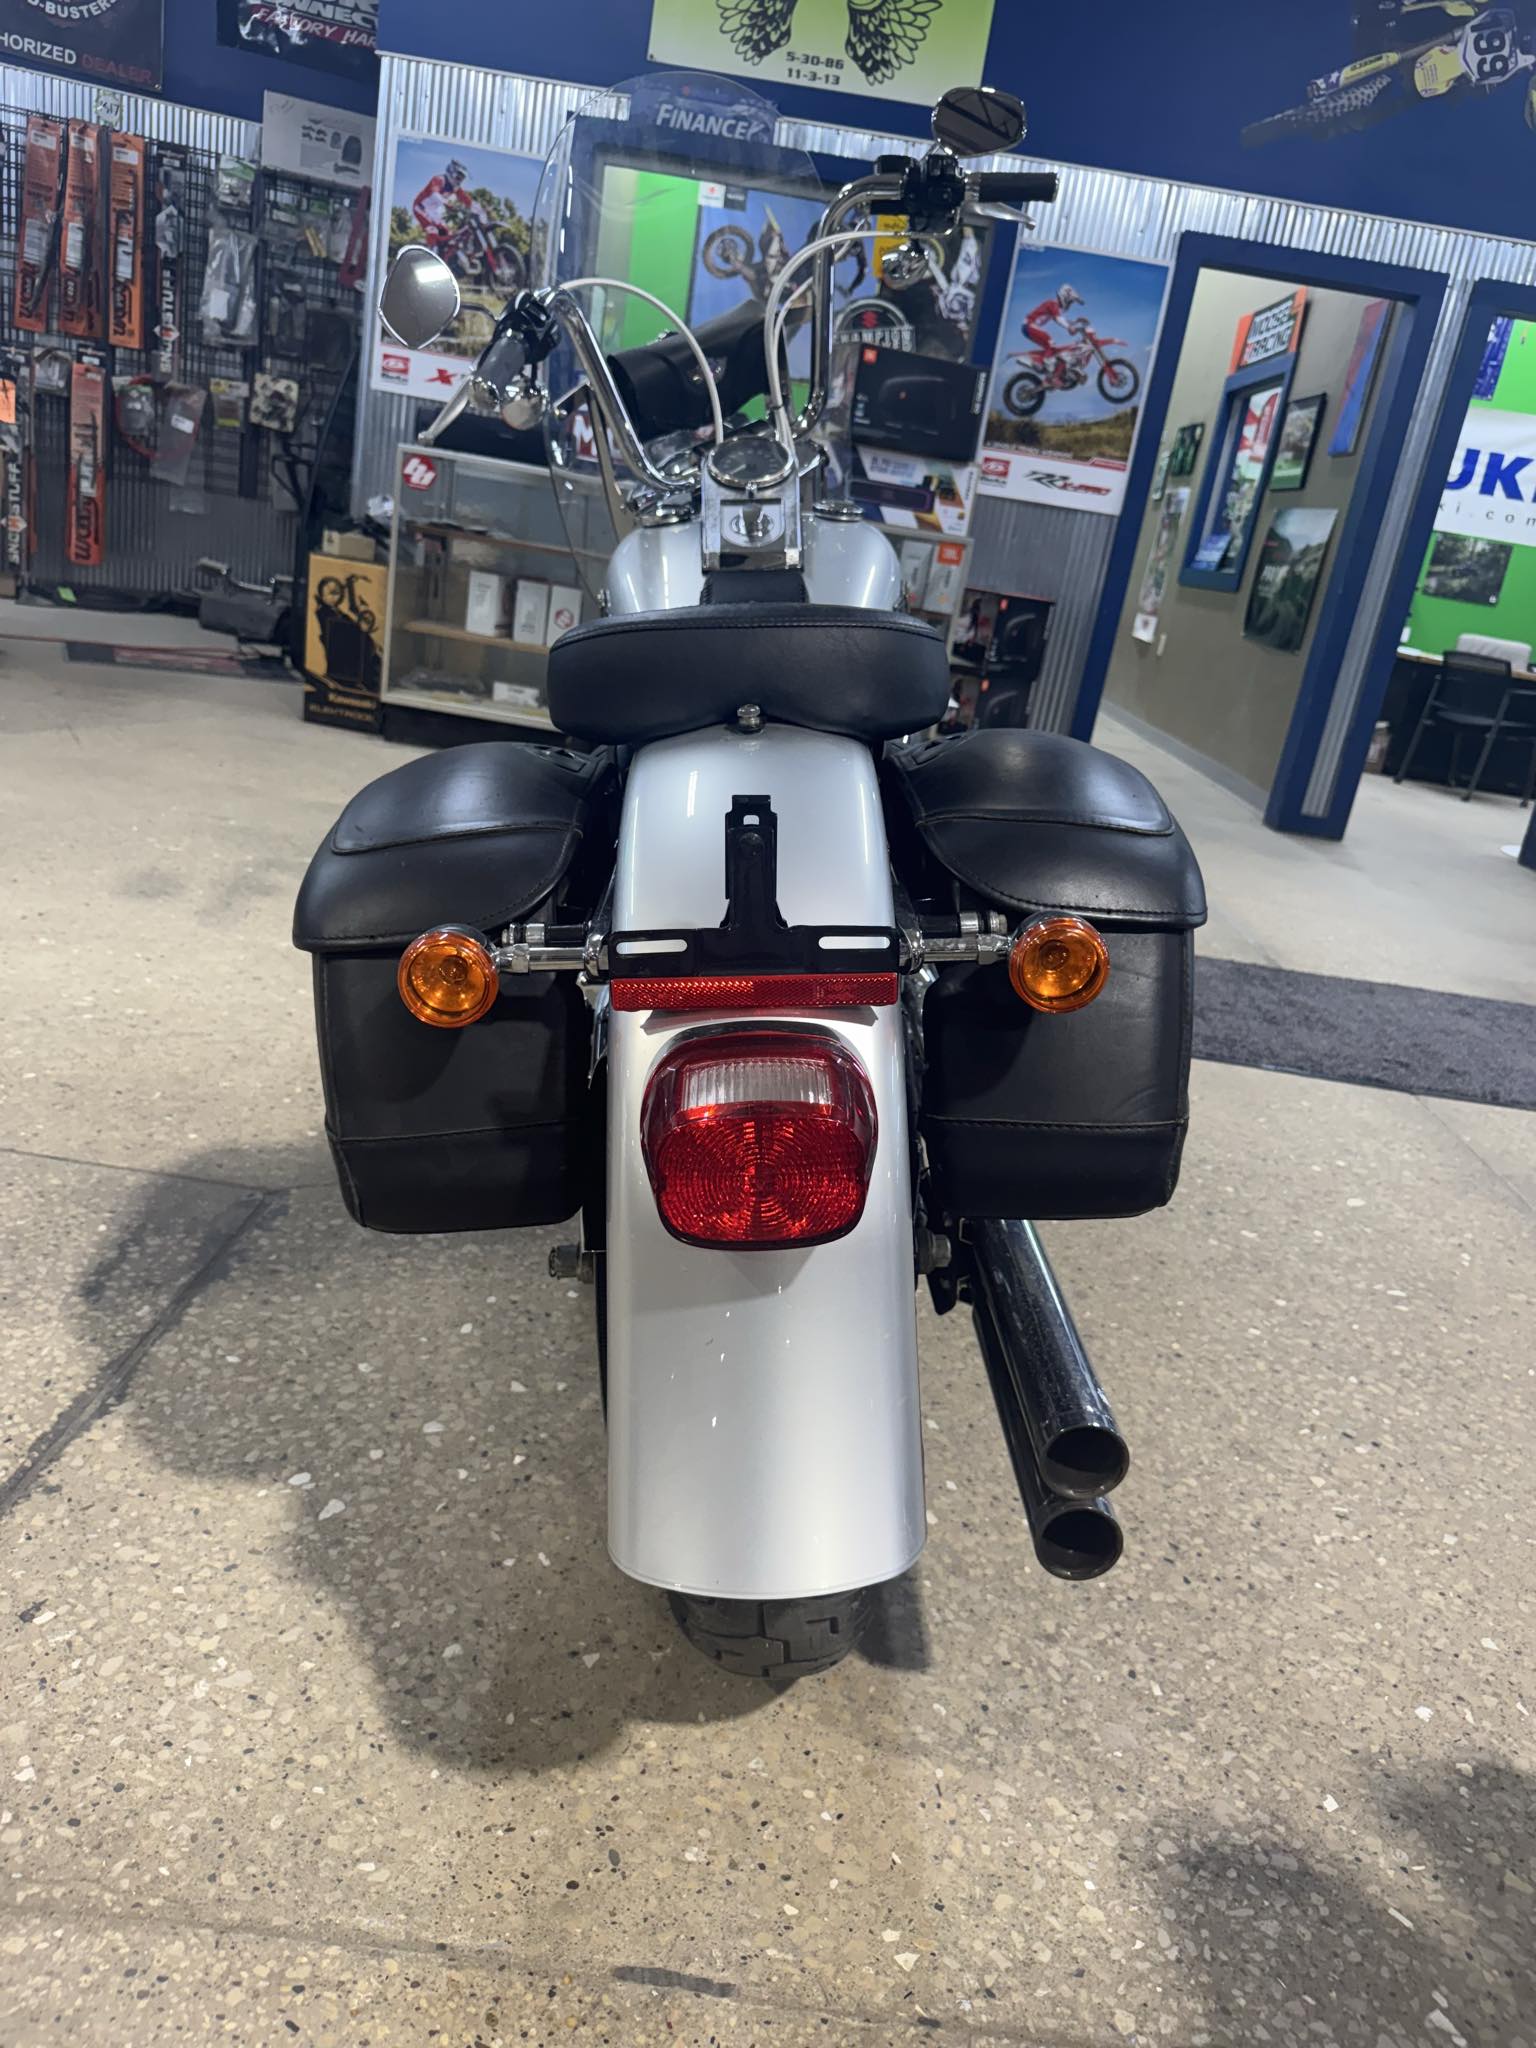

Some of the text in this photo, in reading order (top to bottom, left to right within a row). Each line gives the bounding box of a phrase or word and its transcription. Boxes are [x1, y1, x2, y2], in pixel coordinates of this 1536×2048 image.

[27, 0, 118, 19] -BUSTER
[81, 53, 152, 82] DEALER
[786, 51, 845, 70] 5-30-86
[787, 67, 841, 86] 11-3-13
